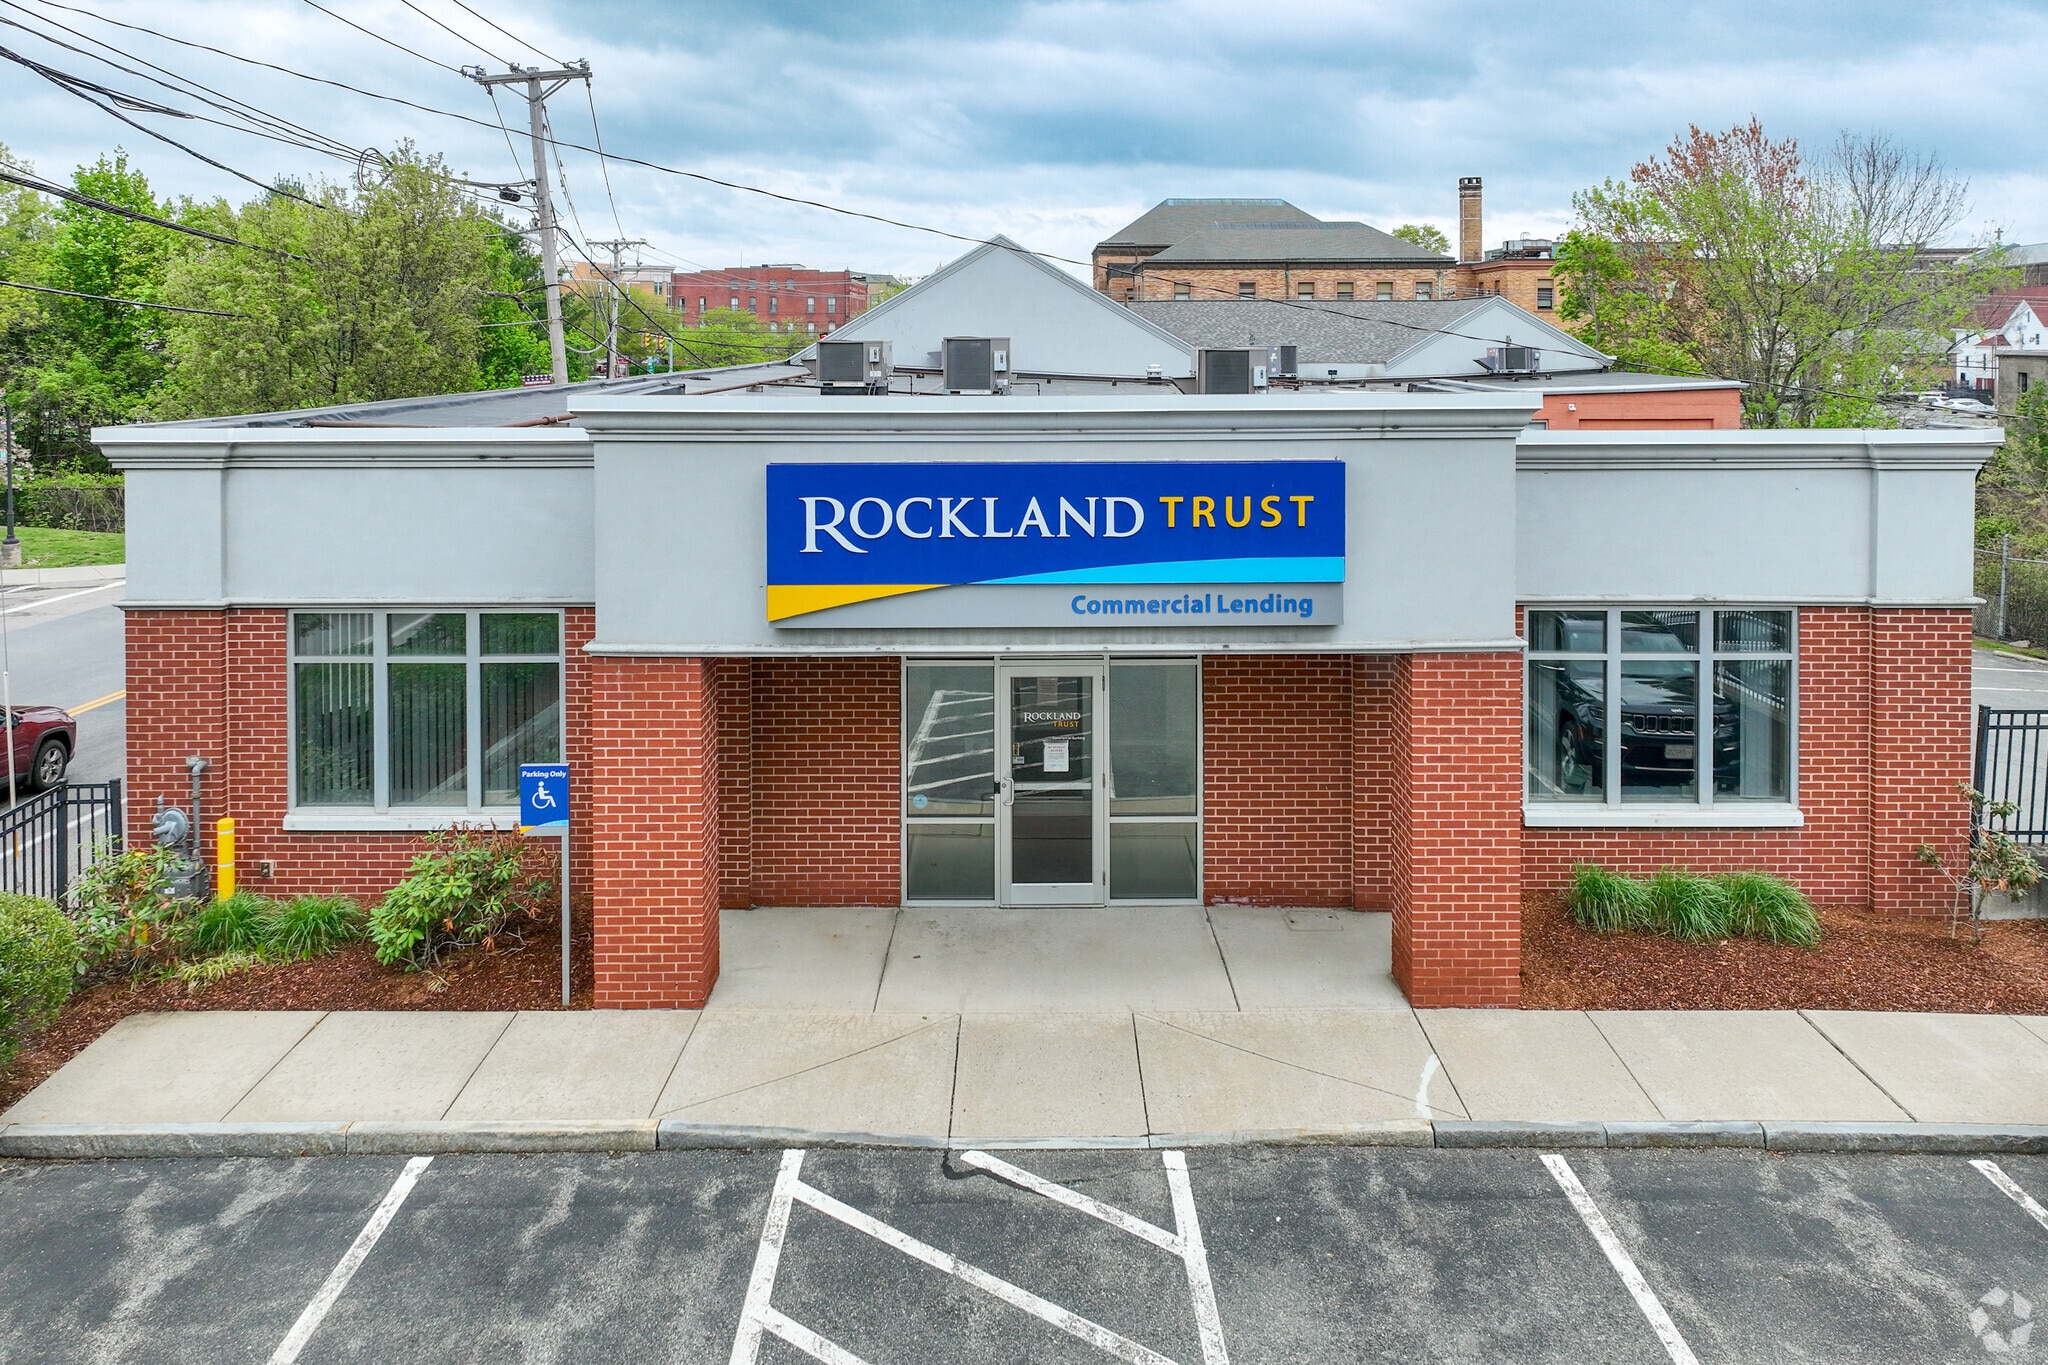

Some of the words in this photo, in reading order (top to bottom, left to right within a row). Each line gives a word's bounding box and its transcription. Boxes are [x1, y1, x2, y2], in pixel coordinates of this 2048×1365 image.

[799, 496, 1145, 553] ROCKLAND
[1159, 495, 1314, 528] TRUST
[1071, 594, 1211, 615] Commercial
[1217, 594, 1313, 618] Lending
[1024, 712, 1081, 723] ROCKLAND
